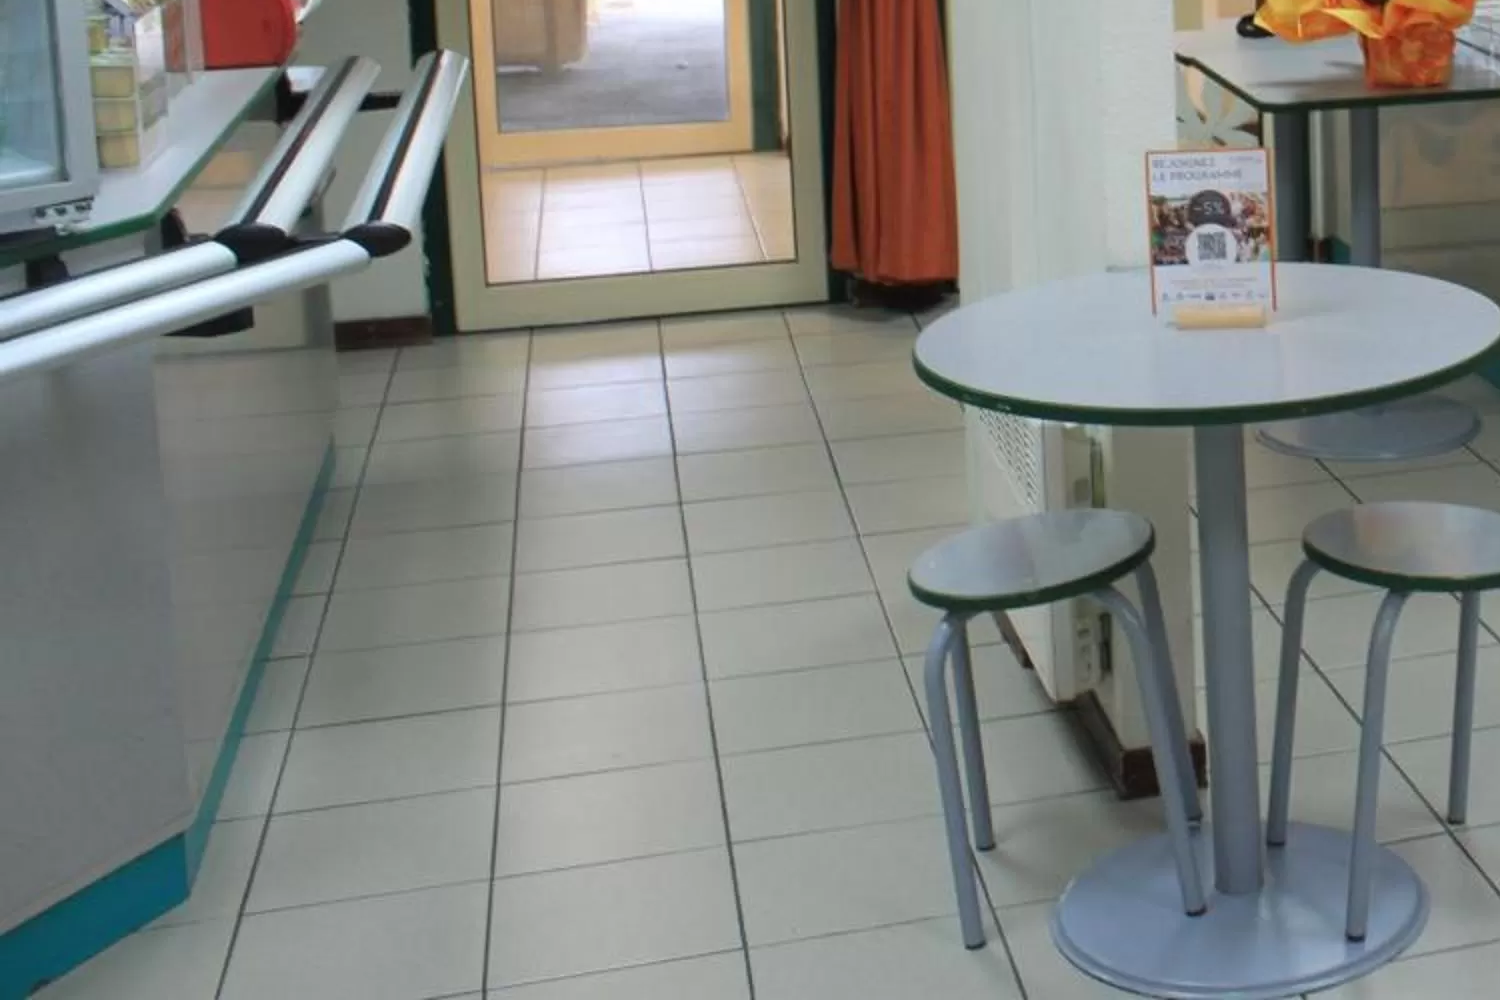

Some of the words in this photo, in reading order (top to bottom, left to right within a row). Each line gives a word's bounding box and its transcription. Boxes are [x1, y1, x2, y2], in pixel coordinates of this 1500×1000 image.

[1152, 157, 1215, 169] REJOIGNEZ
[1152, 172, 1165, 181] LE
[1170, 169, 1242, 181] PROGRAMME
